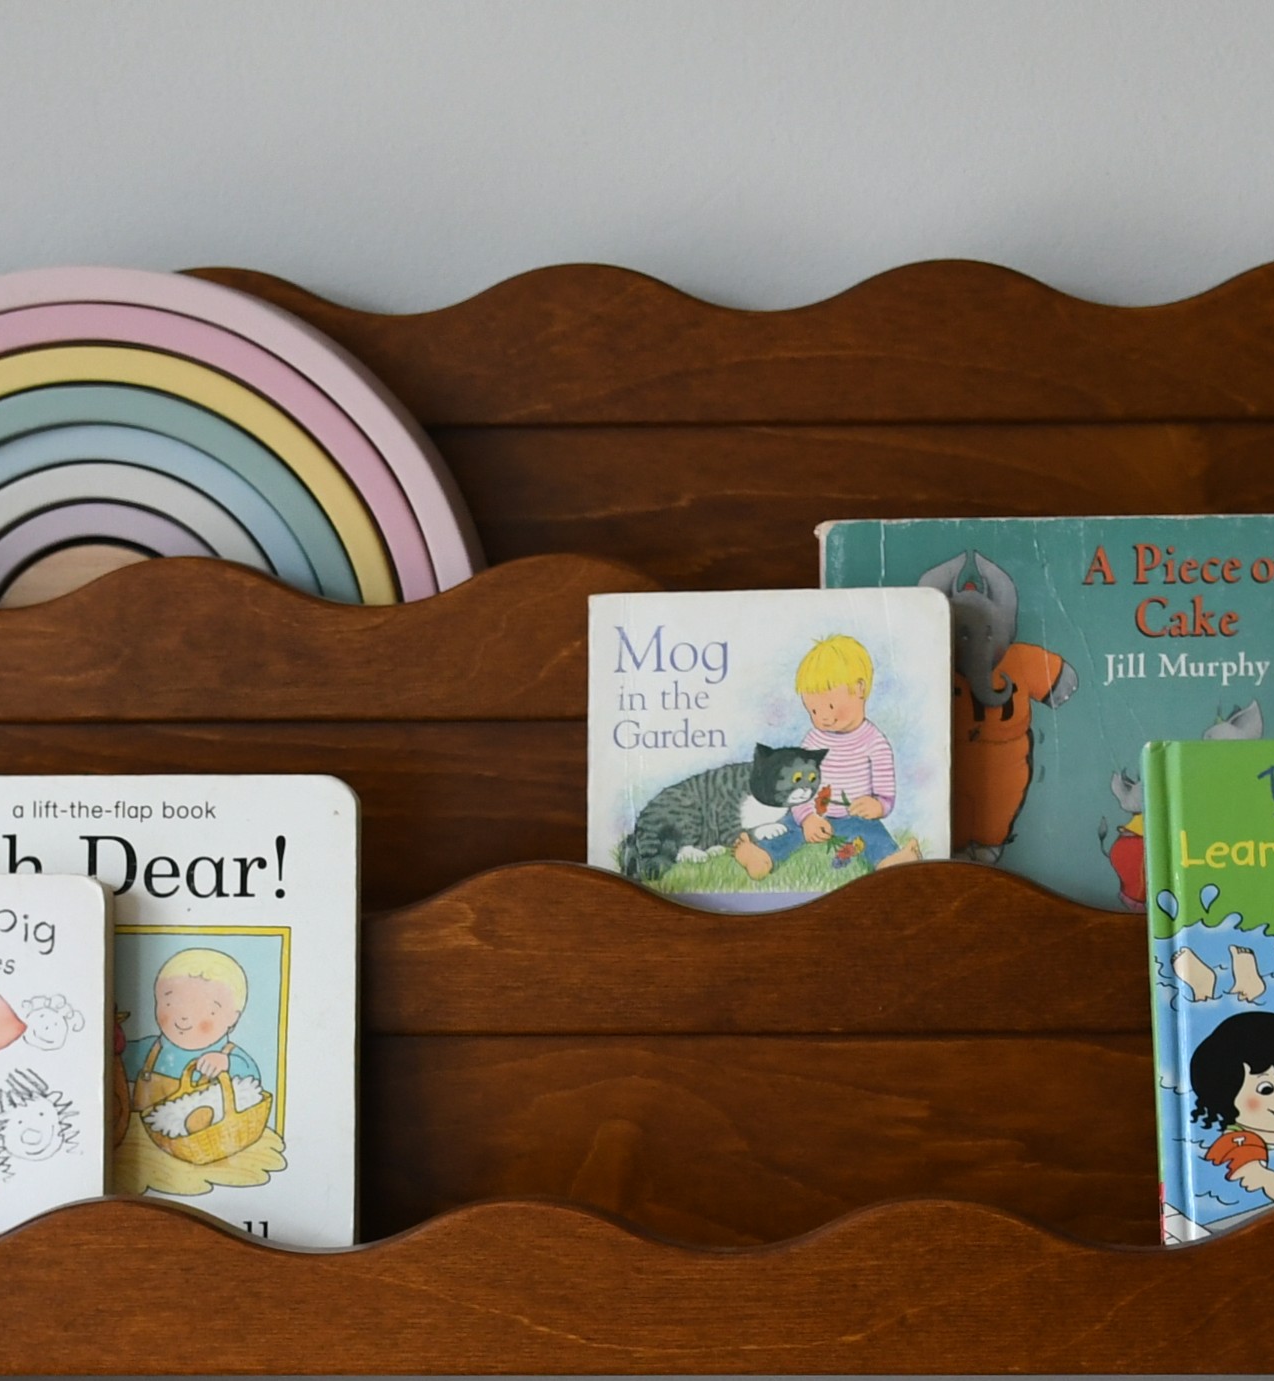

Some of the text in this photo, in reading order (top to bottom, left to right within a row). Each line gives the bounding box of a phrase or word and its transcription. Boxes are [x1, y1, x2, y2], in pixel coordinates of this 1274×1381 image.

[1083, 546, 1116, 586] A
[1134, 542, 1242, 586] Piece
[1135, 596, 1240, 639] Cake
[613, 625, 730, 684] Mog
[1102, 651, 1271, 687] Jill Murphy
[618, 680, 711, 711] in the
[613, 717, 728, 751] Garden
[12, 800, 217, 823] a lift-the-flap book
[78, 834, 287, 900] Dear!
